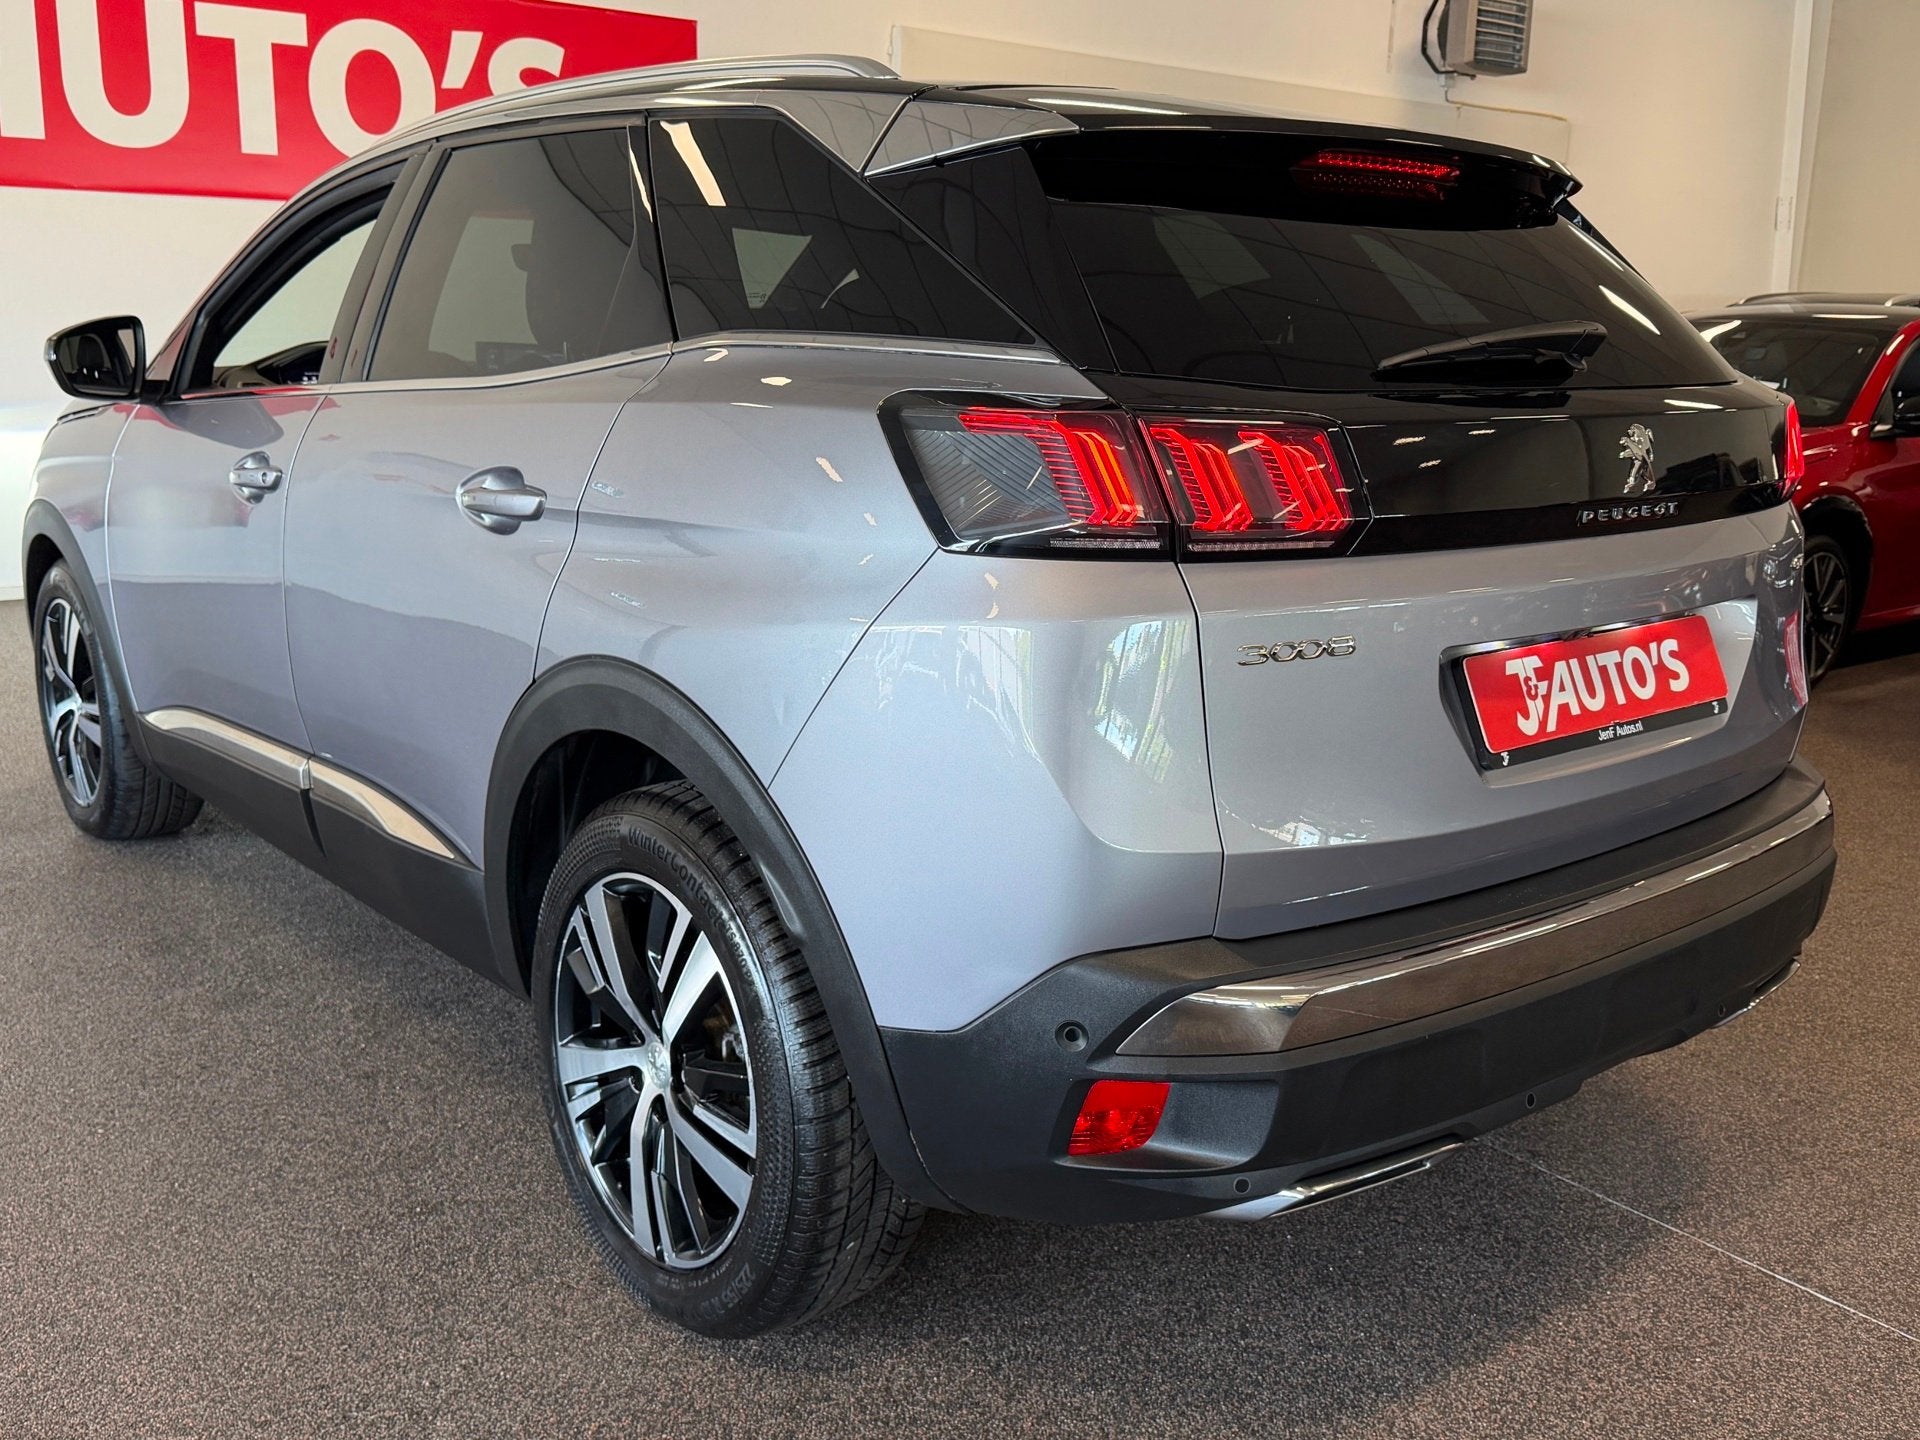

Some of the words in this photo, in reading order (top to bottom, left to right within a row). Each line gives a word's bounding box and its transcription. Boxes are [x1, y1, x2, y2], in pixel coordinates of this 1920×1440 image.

[1581, 501, 1679, 524] PEUGEOT
[1236, 635, 1357, 666] 3008
[1546, 638, 1690, 733] AUTO'S
[1598, 726, 1615, 741] JenF
[1616, 720, 1644, 737] Autos.nl
[628, 825, 723, 928] WinterContact
